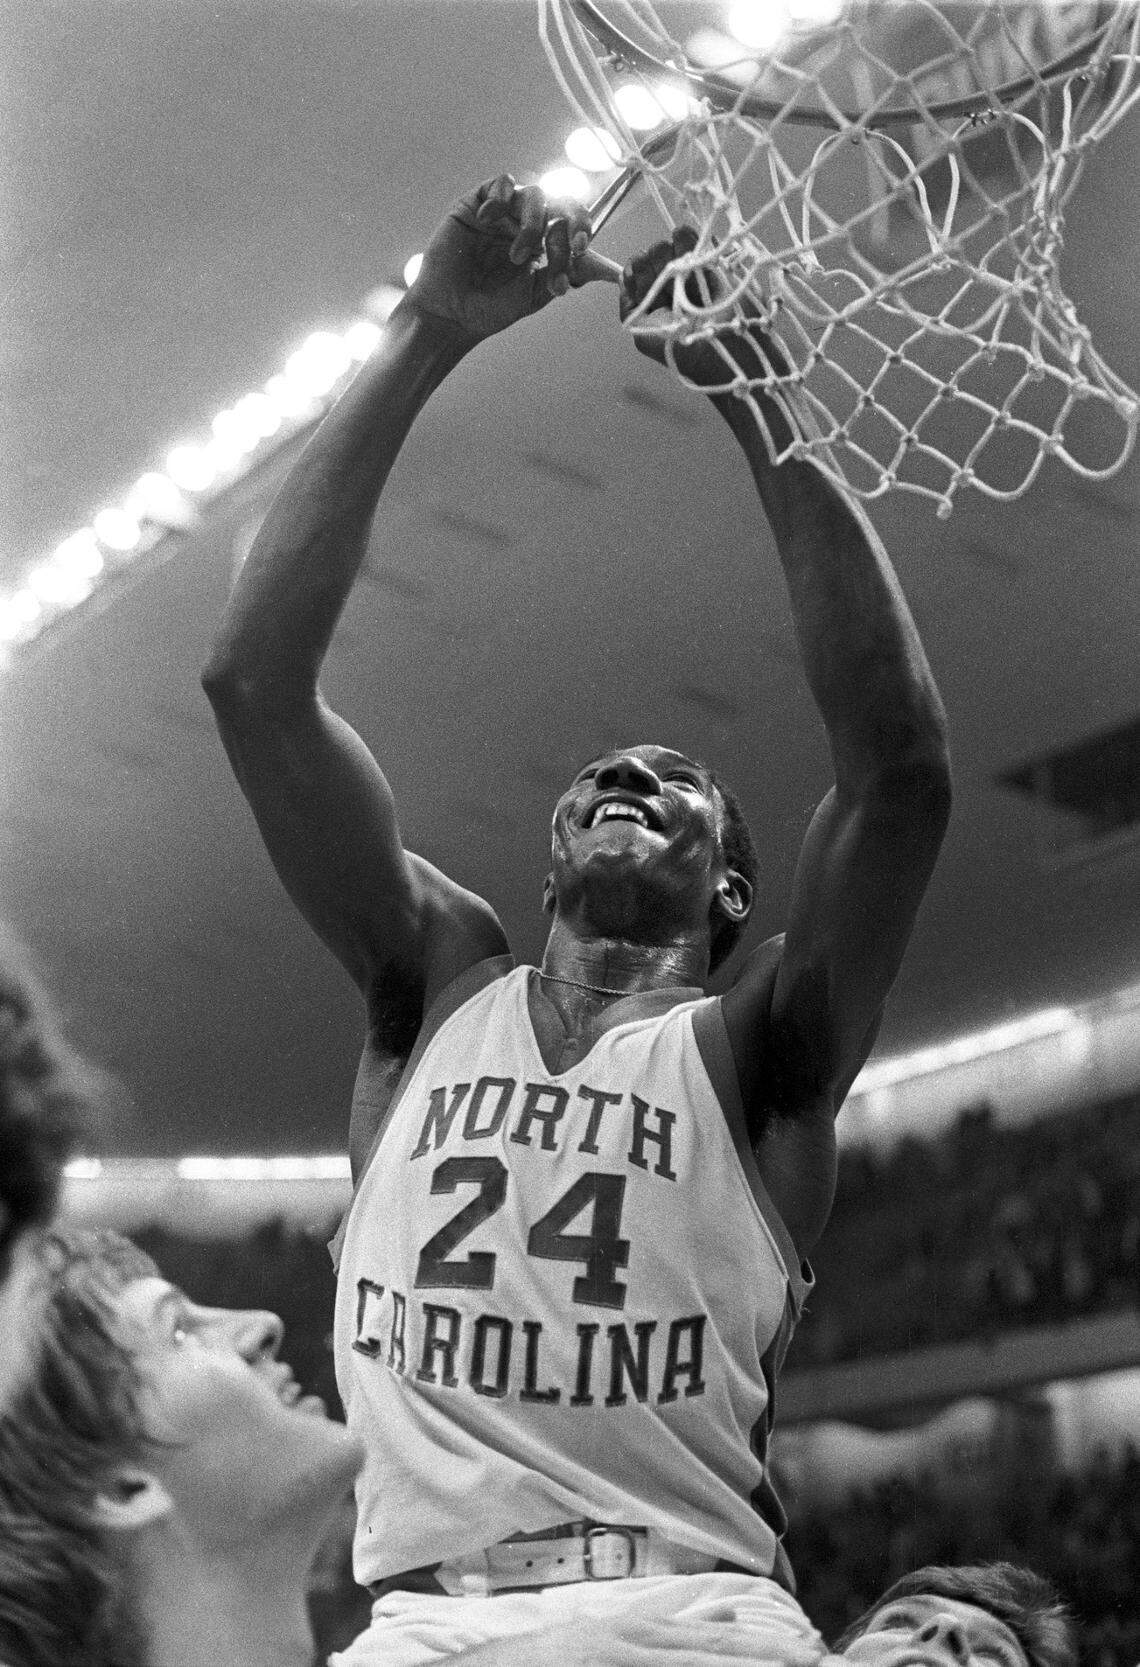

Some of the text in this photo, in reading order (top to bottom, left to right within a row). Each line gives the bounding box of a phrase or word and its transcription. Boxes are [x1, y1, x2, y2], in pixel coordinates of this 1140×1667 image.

[410, 1075, 677, 1182] NORTH
[413, 1156, 630, 1310] 24
[352, 1277, 707, 1407] CAROLINA
